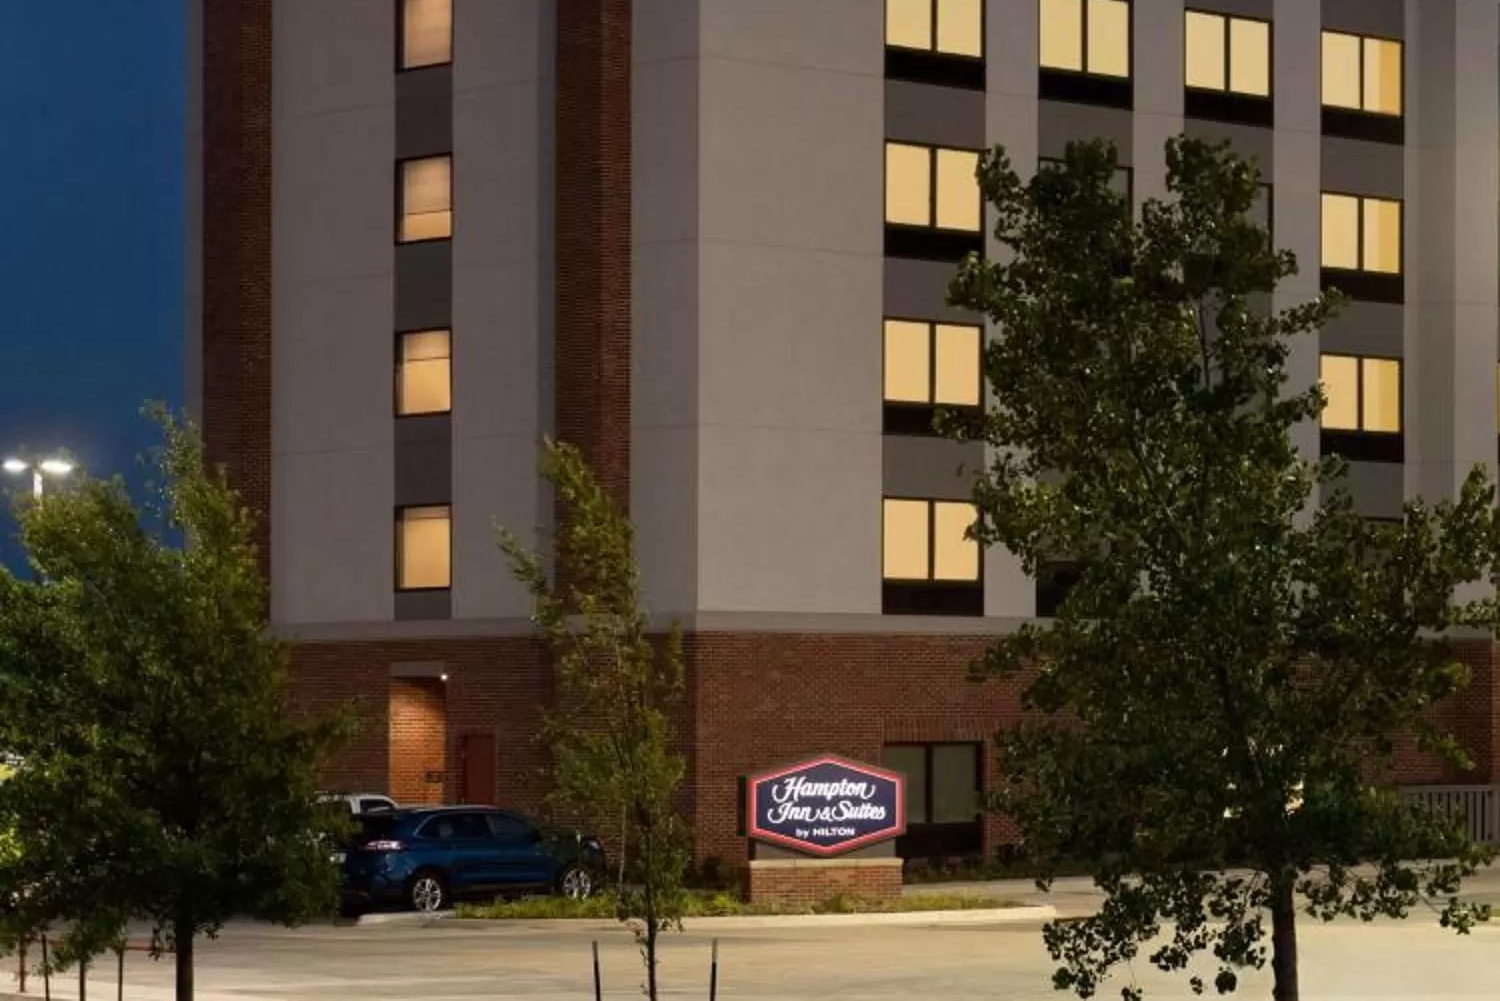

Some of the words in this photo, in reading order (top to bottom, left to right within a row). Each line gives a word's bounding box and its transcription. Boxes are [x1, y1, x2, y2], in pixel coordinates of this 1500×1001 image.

[771, 775, 877, 804] Hampton
[766, 801, 820, 825] Inn
[819, 808, 834, 822] &
[831, 800, 887, 822] Suites
[795, 828, 810, 839] by
[812, 827, 855, 837] HILTON
